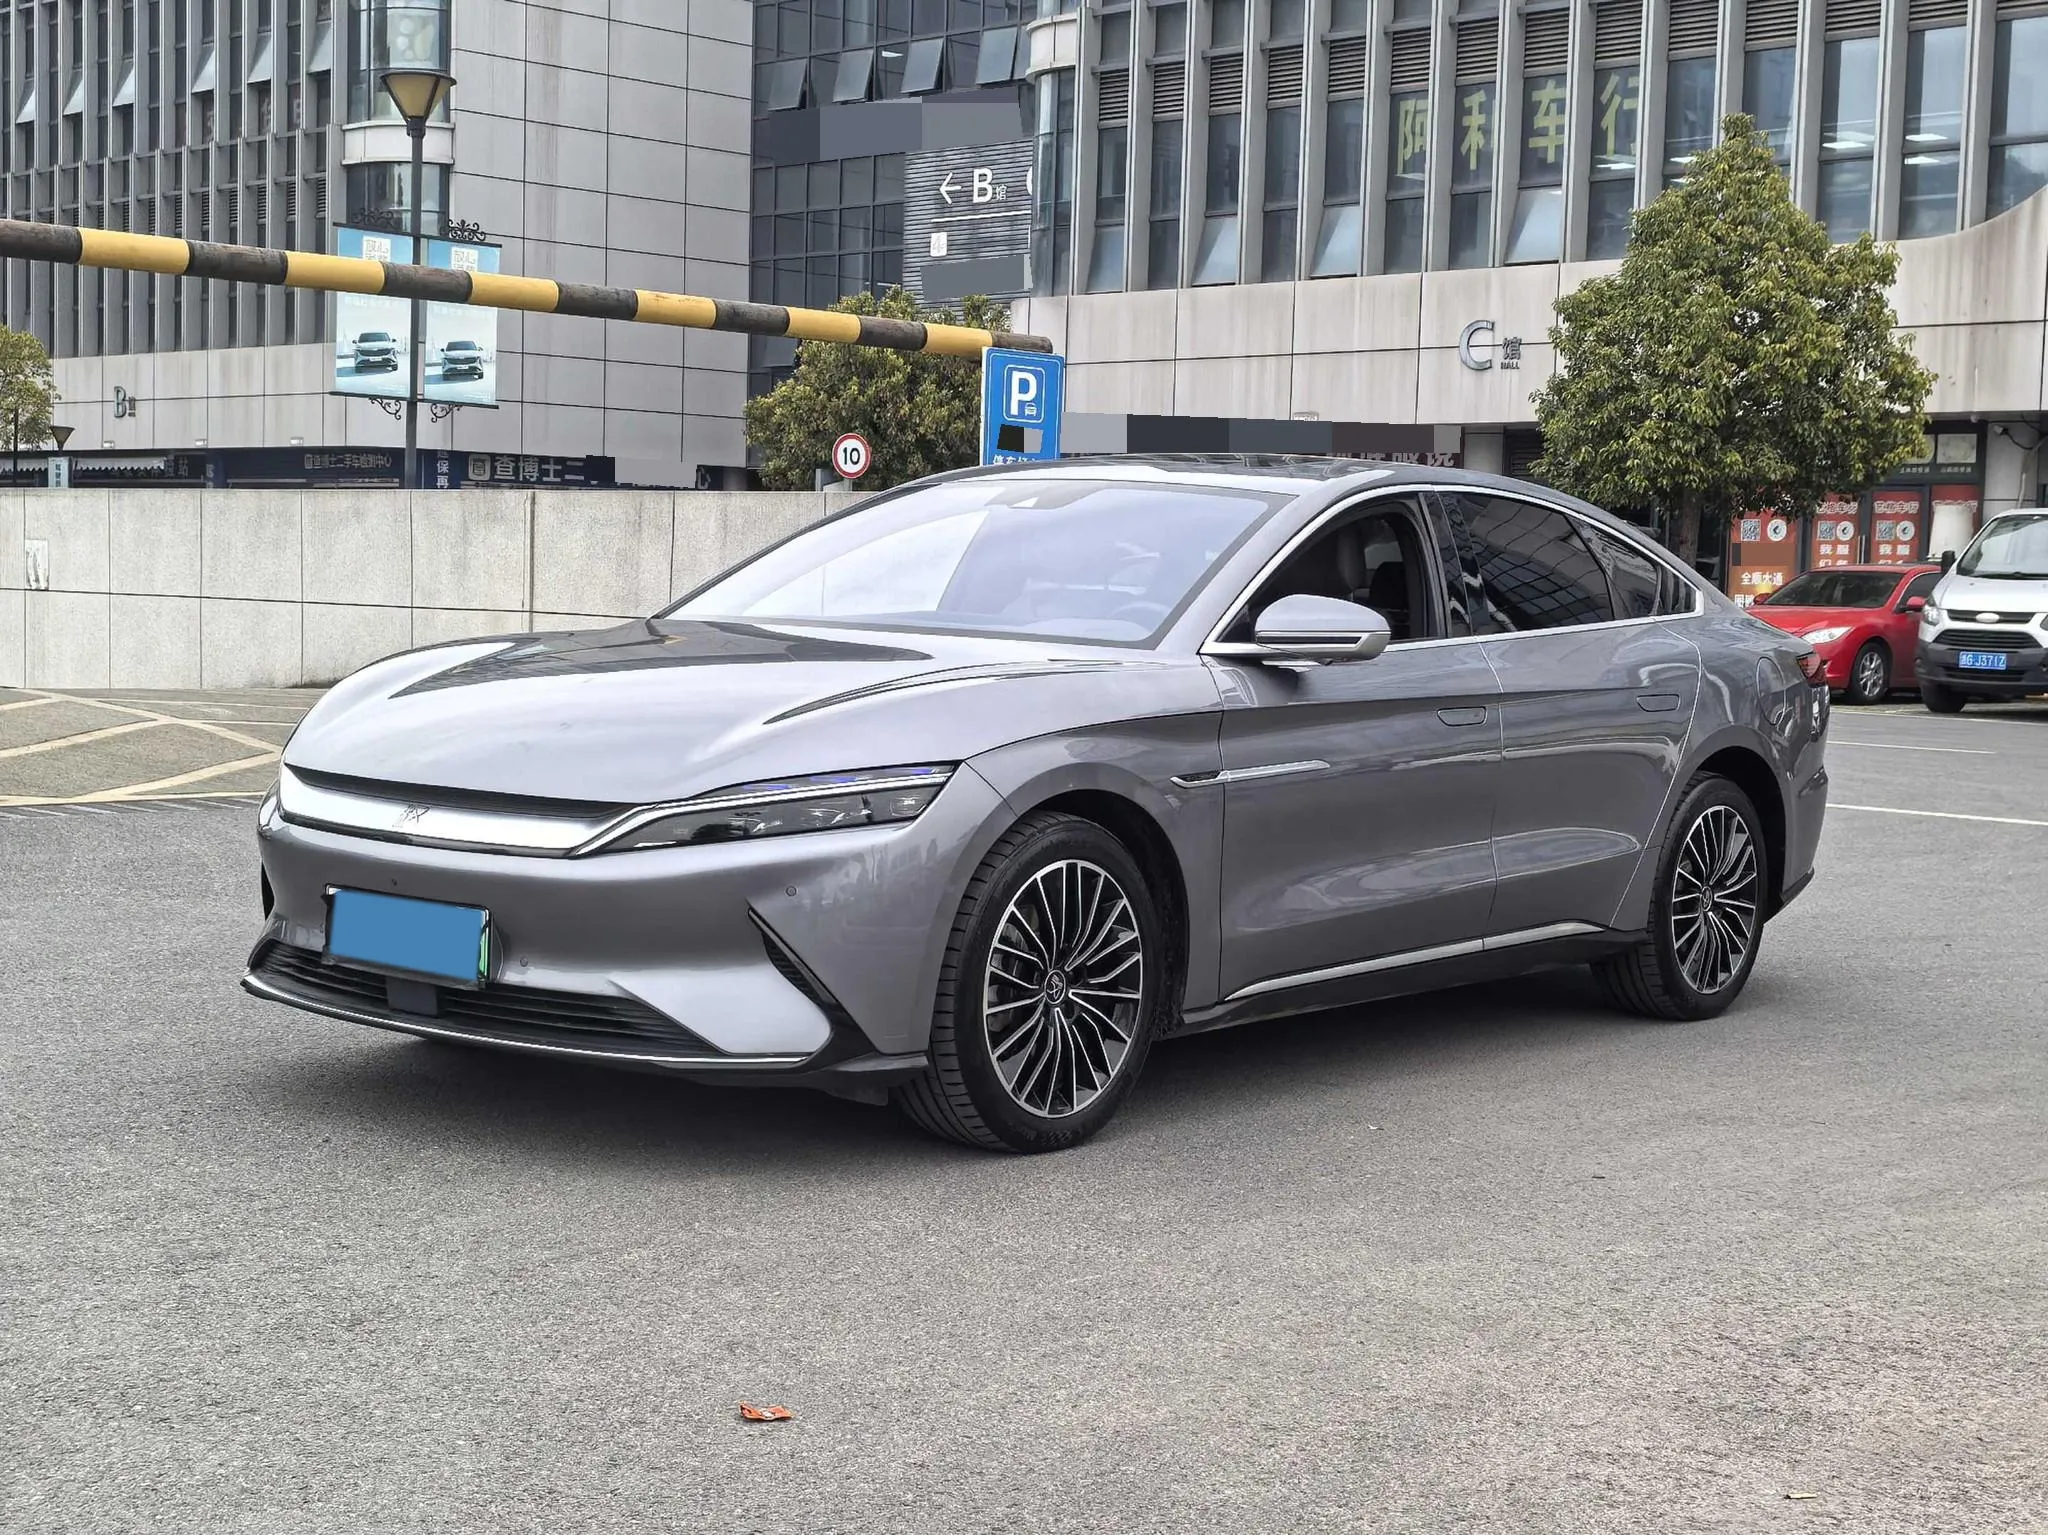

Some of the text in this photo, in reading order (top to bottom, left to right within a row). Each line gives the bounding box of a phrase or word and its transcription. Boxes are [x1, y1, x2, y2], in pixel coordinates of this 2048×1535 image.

[1459, 319, 1494, 371] C
[1500, 362, 1520, 370] HALL
[113, 385, 127, 418] B
[1010, 370, 1037, 416] P
[843, 447, 860, 465] 10
